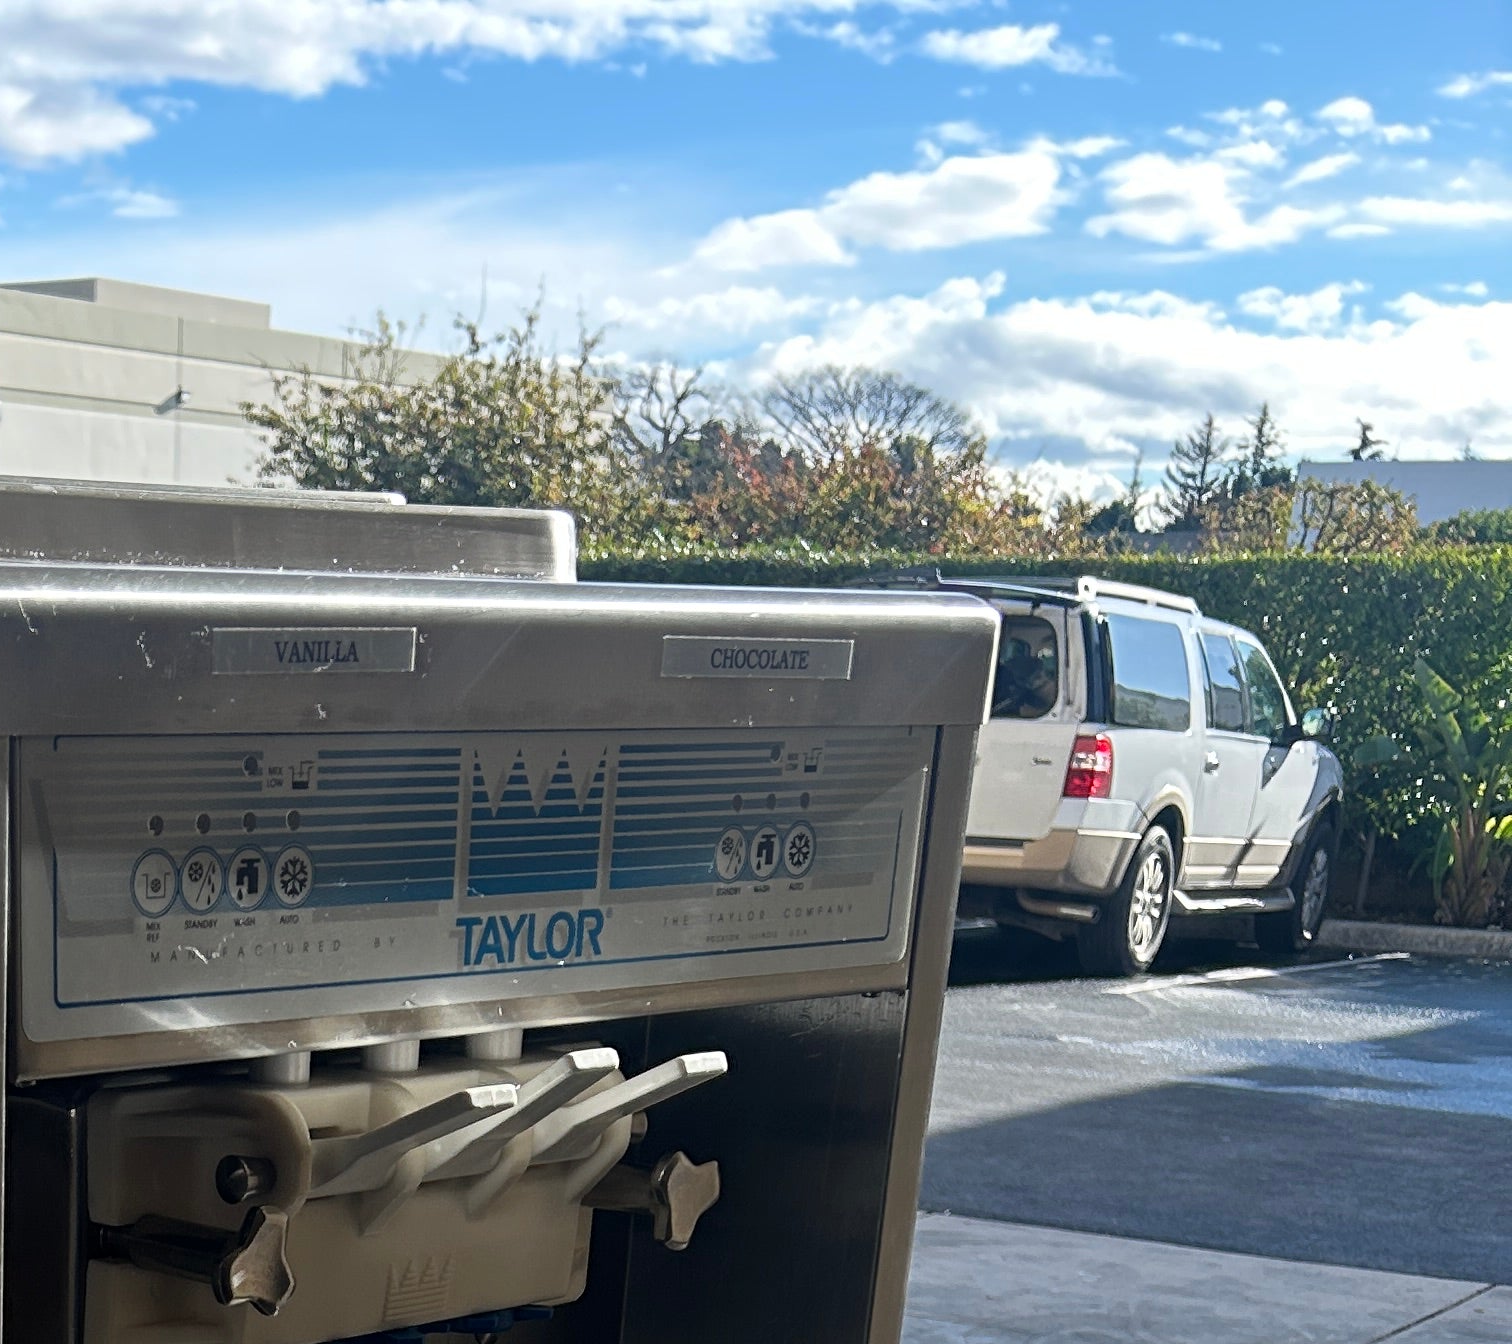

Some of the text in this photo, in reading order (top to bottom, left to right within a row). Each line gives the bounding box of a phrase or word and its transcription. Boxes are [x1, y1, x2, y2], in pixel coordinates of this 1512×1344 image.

[274, 640, 360, 664] VANILLA
[710, 648, 810, 670] CHOCOLATE
[184, 918, 218, 930] STANDBY
[279, 914, 299, 926] AUTO
[663, 903, 854, 927] THE TAYLOR COMPANY
[455, 908, 605, 967] TAYLOR
[150, 936, 397, 964] MANUFACTURED BY
